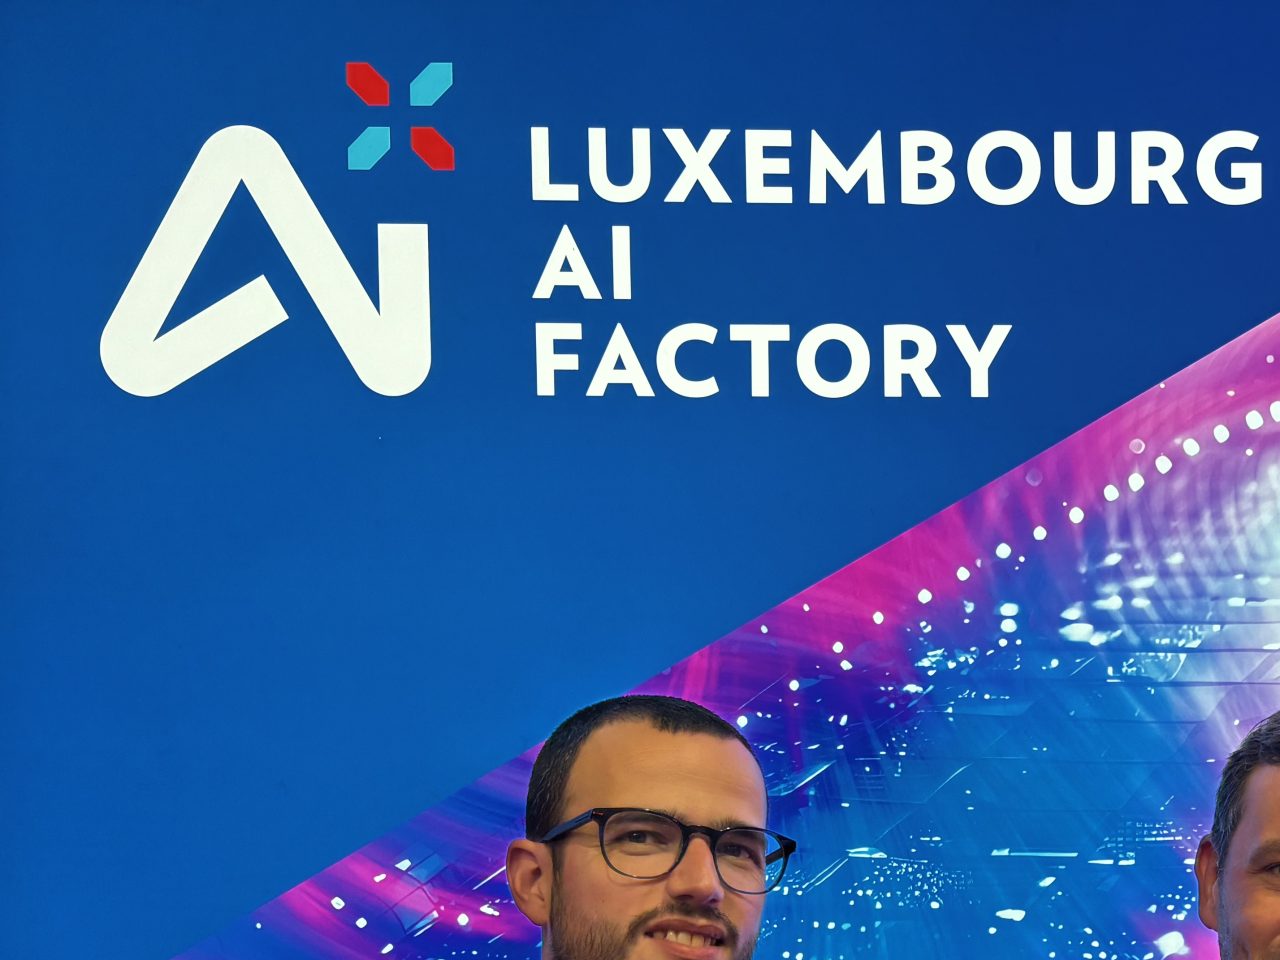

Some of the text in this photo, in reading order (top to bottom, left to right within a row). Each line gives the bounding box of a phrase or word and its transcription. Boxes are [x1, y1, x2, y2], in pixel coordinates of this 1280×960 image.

[530, 126, 1263, 207] LUXEMBOURG
[532, 224, 633, 301] AI
[535, 323, 1014, 399] FACTORY
